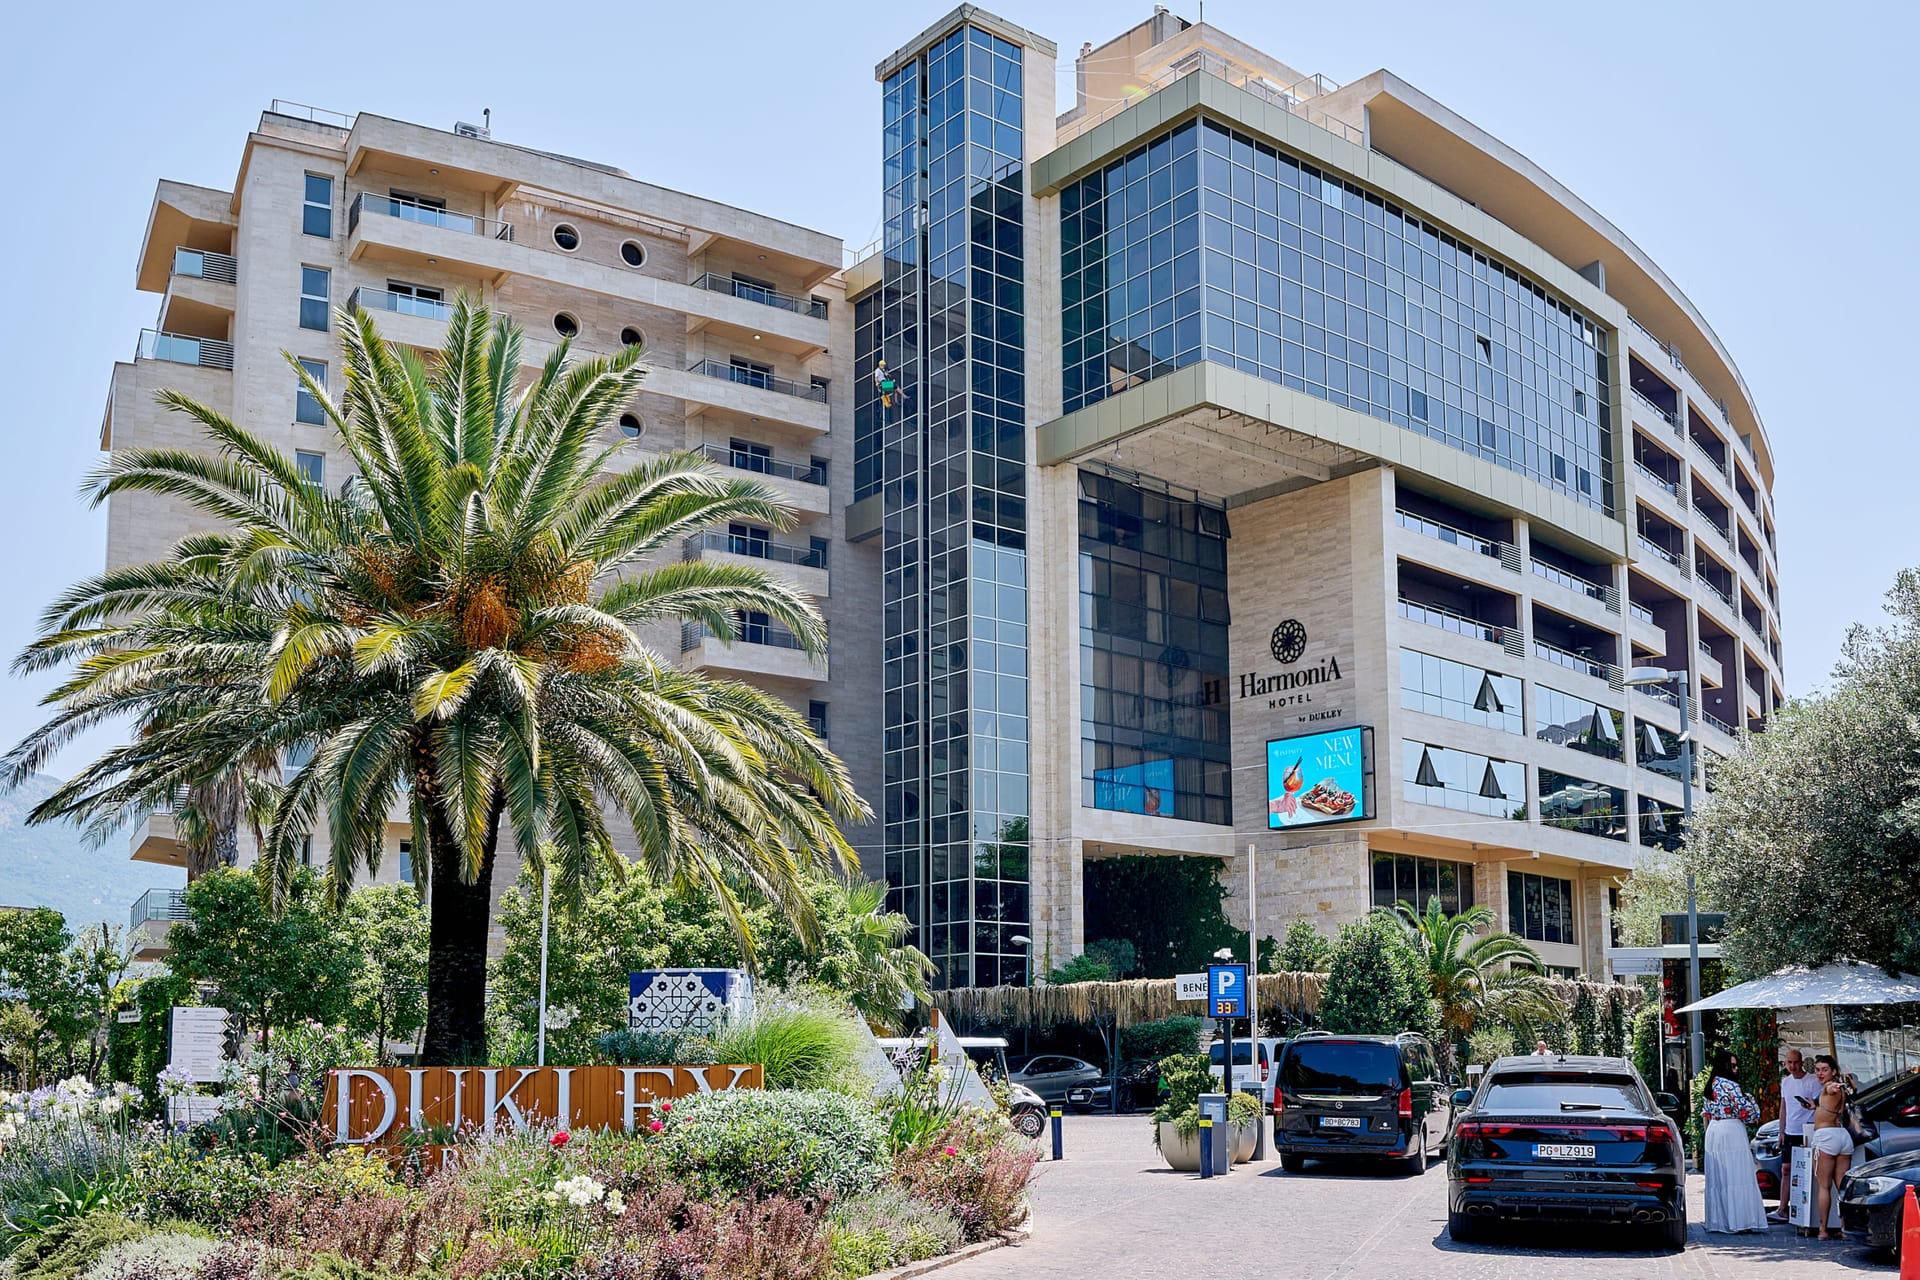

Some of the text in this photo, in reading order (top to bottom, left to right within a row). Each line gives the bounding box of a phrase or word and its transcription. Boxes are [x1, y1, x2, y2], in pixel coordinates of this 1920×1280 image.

[1239, 656, 1342, 699] HarmoniA
[1269, 693, 1312, 709] HOTEL
[1309, 709, 1342, 722] DUKLEY
[1324, 735, 1356, 752] NEW
[1315, 750, 1356, 770] MENU
[1218, 971, 1236, 995] P
[1217, 1002, 1232, 1014] 33
[1539, 1145, 1594, 1157] PG LZ919
